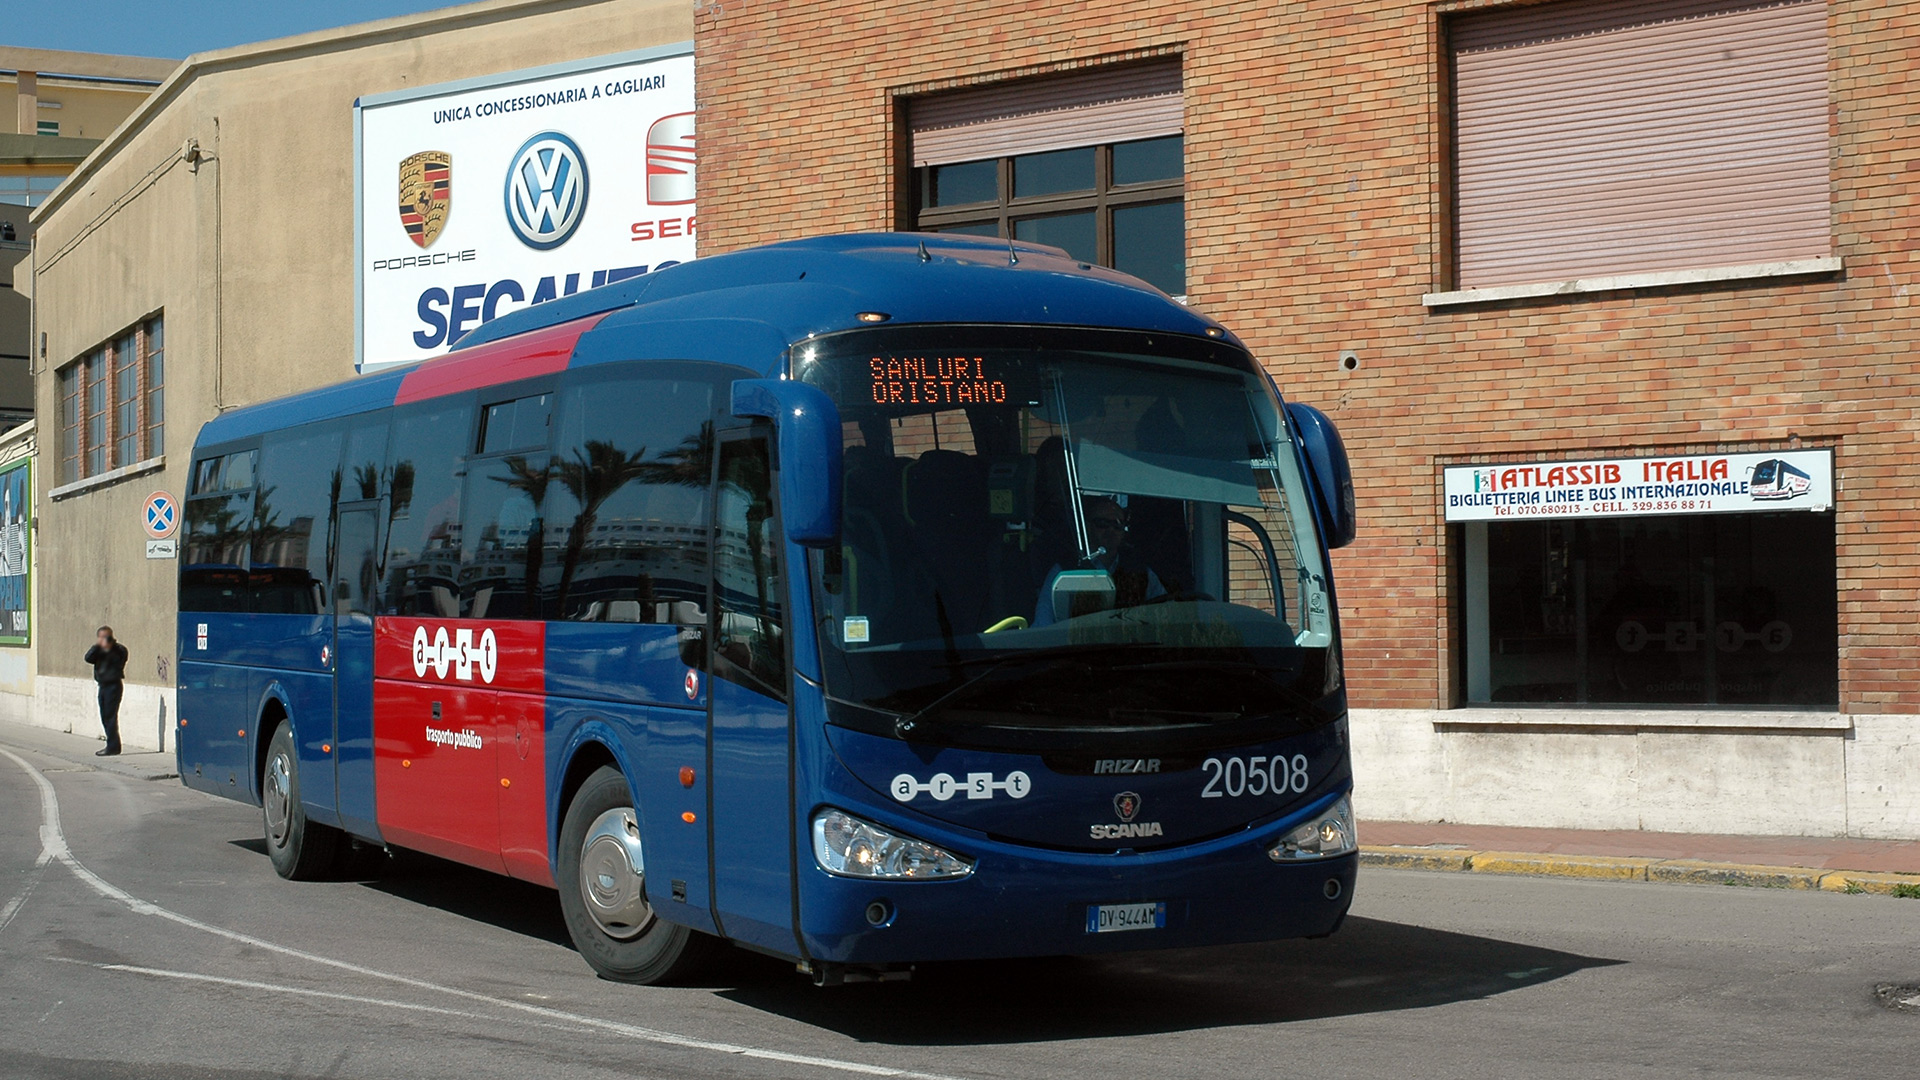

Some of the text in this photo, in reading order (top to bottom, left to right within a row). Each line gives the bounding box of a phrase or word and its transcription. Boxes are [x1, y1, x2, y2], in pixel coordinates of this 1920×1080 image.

[433, 75, 666, 124] UNICA CONCESSIONARIA A CAGLIARI
[400, 152, 449, 170] PORSCHE
[373, 249, 477, 272] PORSCHE
[869, 357, 985, 379] SANLURI
[872, 381, 1006, 403] ORISTANO
[1501, 459, 1728, 490] ATLASSIB ITALIA
[1450, 481, 1749, 507] BIGLIETTERIA LINEE BUS INTERNAZIONALE
[1493, 505, 1514, 515] Tel.
[1517, 505, 1581, 515] 070.680213
[1592, 502, 1628, 513] CELL.
[1632, 500, 1678, 511] 329.836
[1681, 500, 1695, 509] 88
[1699, 500, 1712, 509] 71
[426, 725, 482, 750] trasporto pubblico
[1094, 759, 1161, 774] IRIZAR
[1201, 754, 1309, 798] 20508
[1090, 822, 1163, 839] SCANIA
